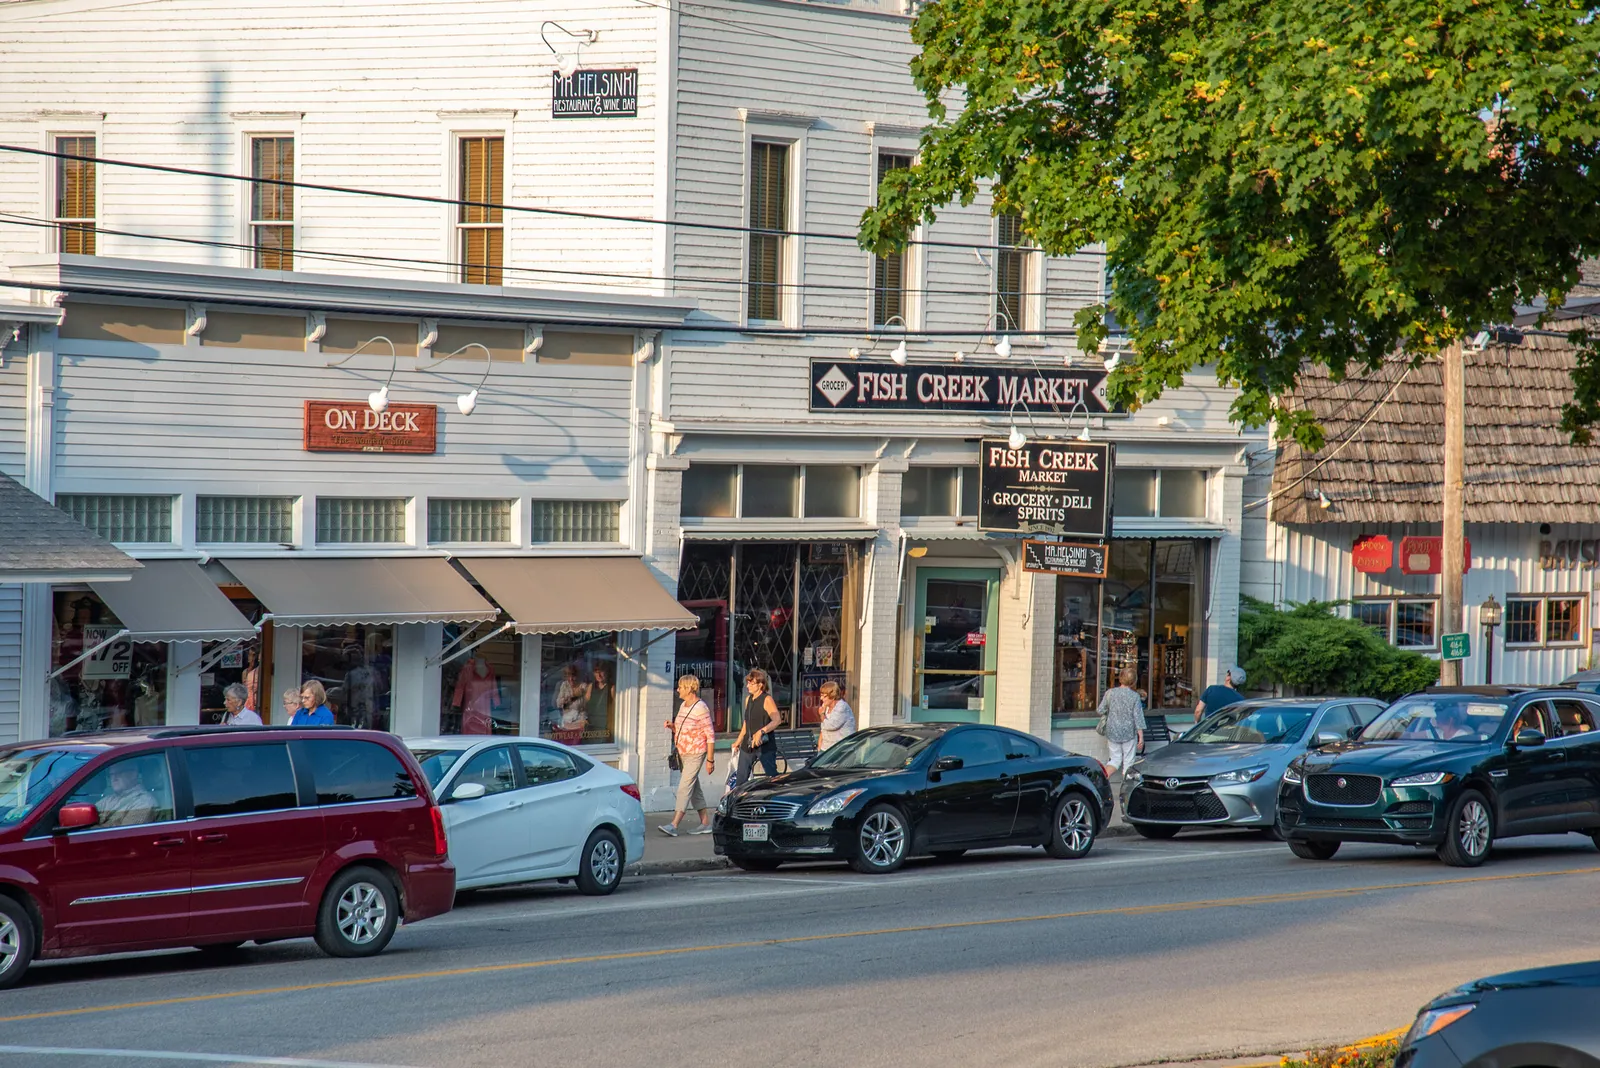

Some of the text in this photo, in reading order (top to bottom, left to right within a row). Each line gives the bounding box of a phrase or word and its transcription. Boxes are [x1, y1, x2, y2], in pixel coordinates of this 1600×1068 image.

[553, 96, 636, 115] RESTAURANT & WINE BAR
[821, 380, 848, 391] GROCERY
[857, 371, 1089, 404] FISH CREEK MARKET
[324, 408, 420, 432] ON DECK
[989, 446, 1099, 471] FISH CREEK
[1018, 469, 1068, 483] MARKET
[992, 492, 1092, 509] GROCERY DELI
[1017, 507, 1065, 521] SPIRITS
[86, 629, 107, 640] NOW
[112, 662, 129, 672] OFF
